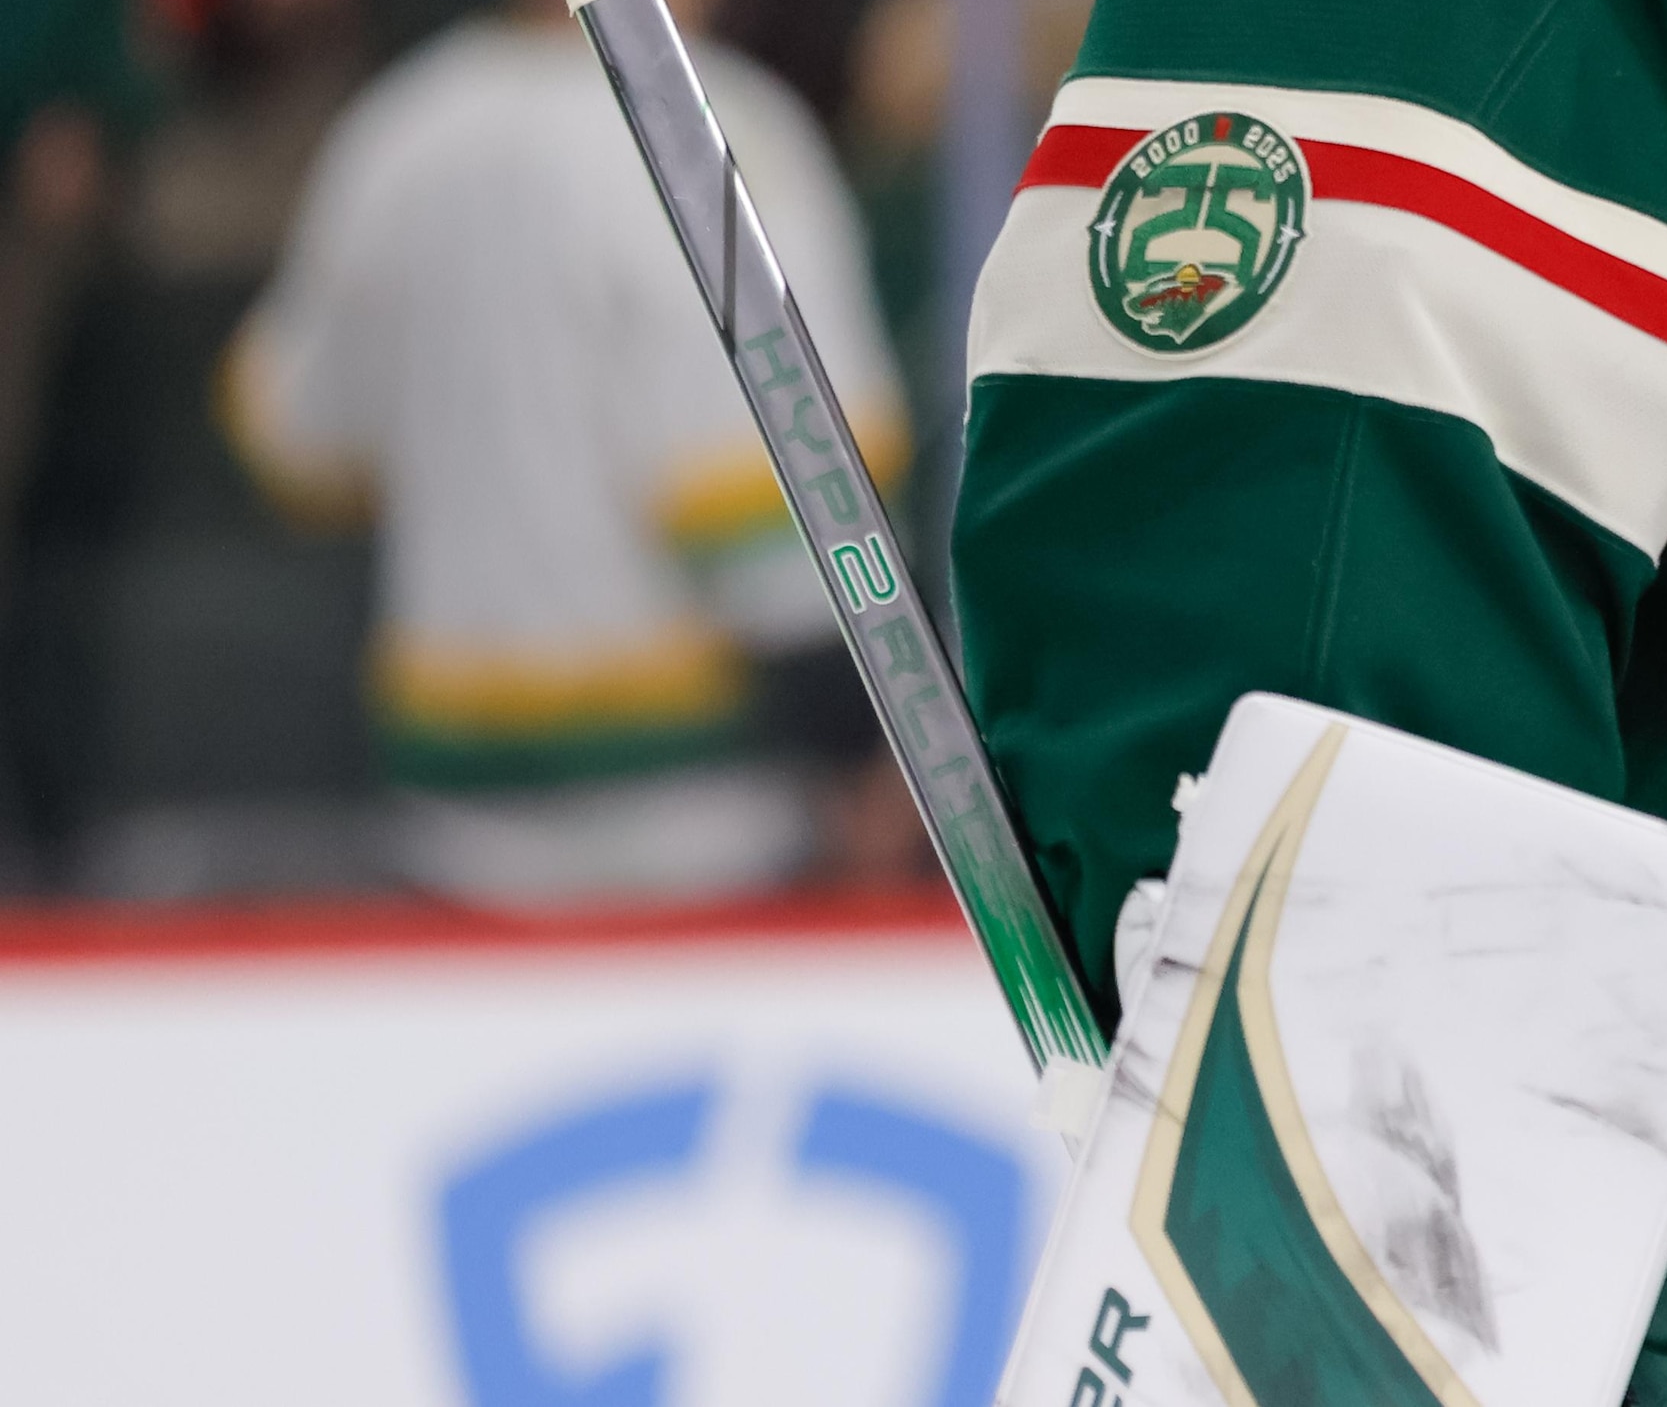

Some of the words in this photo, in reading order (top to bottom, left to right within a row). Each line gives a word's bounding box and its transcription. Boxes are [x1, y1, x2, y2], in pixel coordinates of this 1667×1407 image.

[1129, 120, 1200, 180] 2000
[1242, 125, 1297, 184] 2025
[1122, 162, 1275, 292] 25
